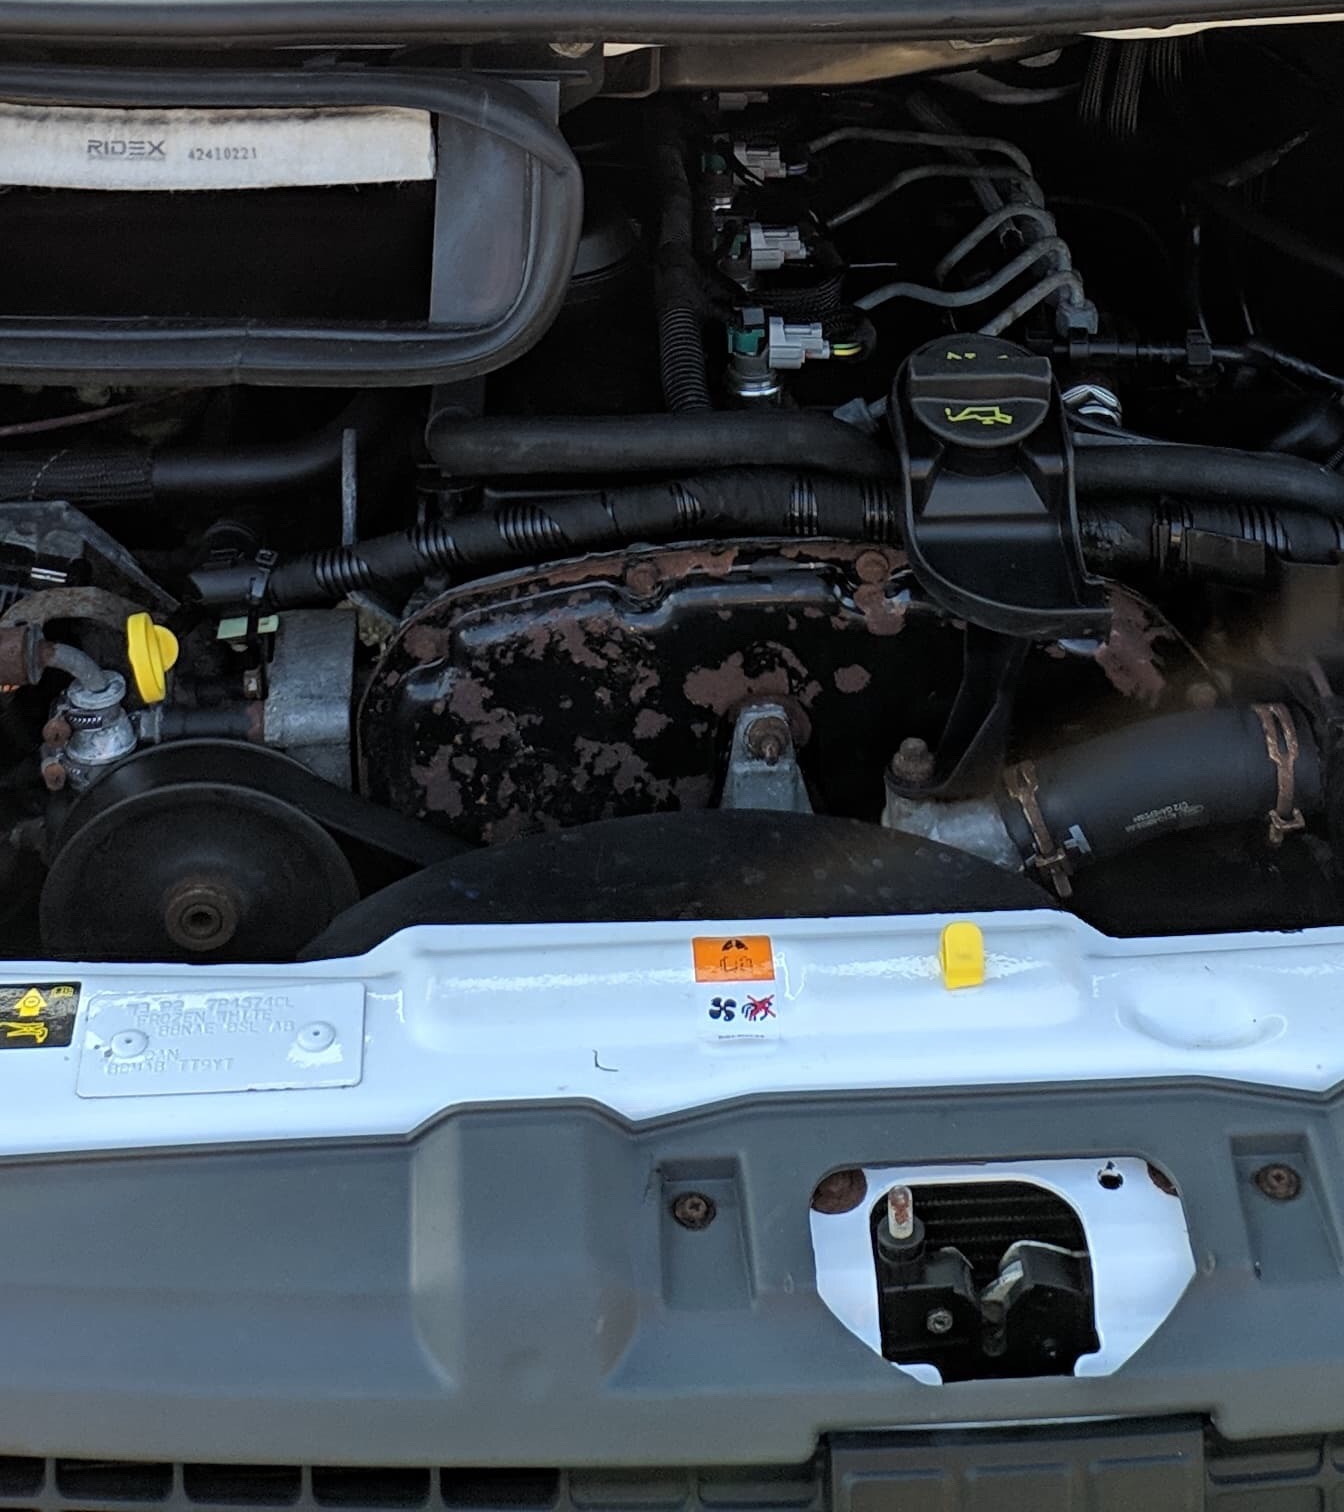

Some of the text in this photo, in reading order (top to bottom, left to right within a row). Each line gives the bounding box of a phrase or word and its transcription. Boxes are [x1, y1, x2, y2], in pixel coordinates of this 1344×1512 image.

[87, 139, 257, 160] RIDEX 42410221
[137, 1010, 206, 1029] FROZEN
